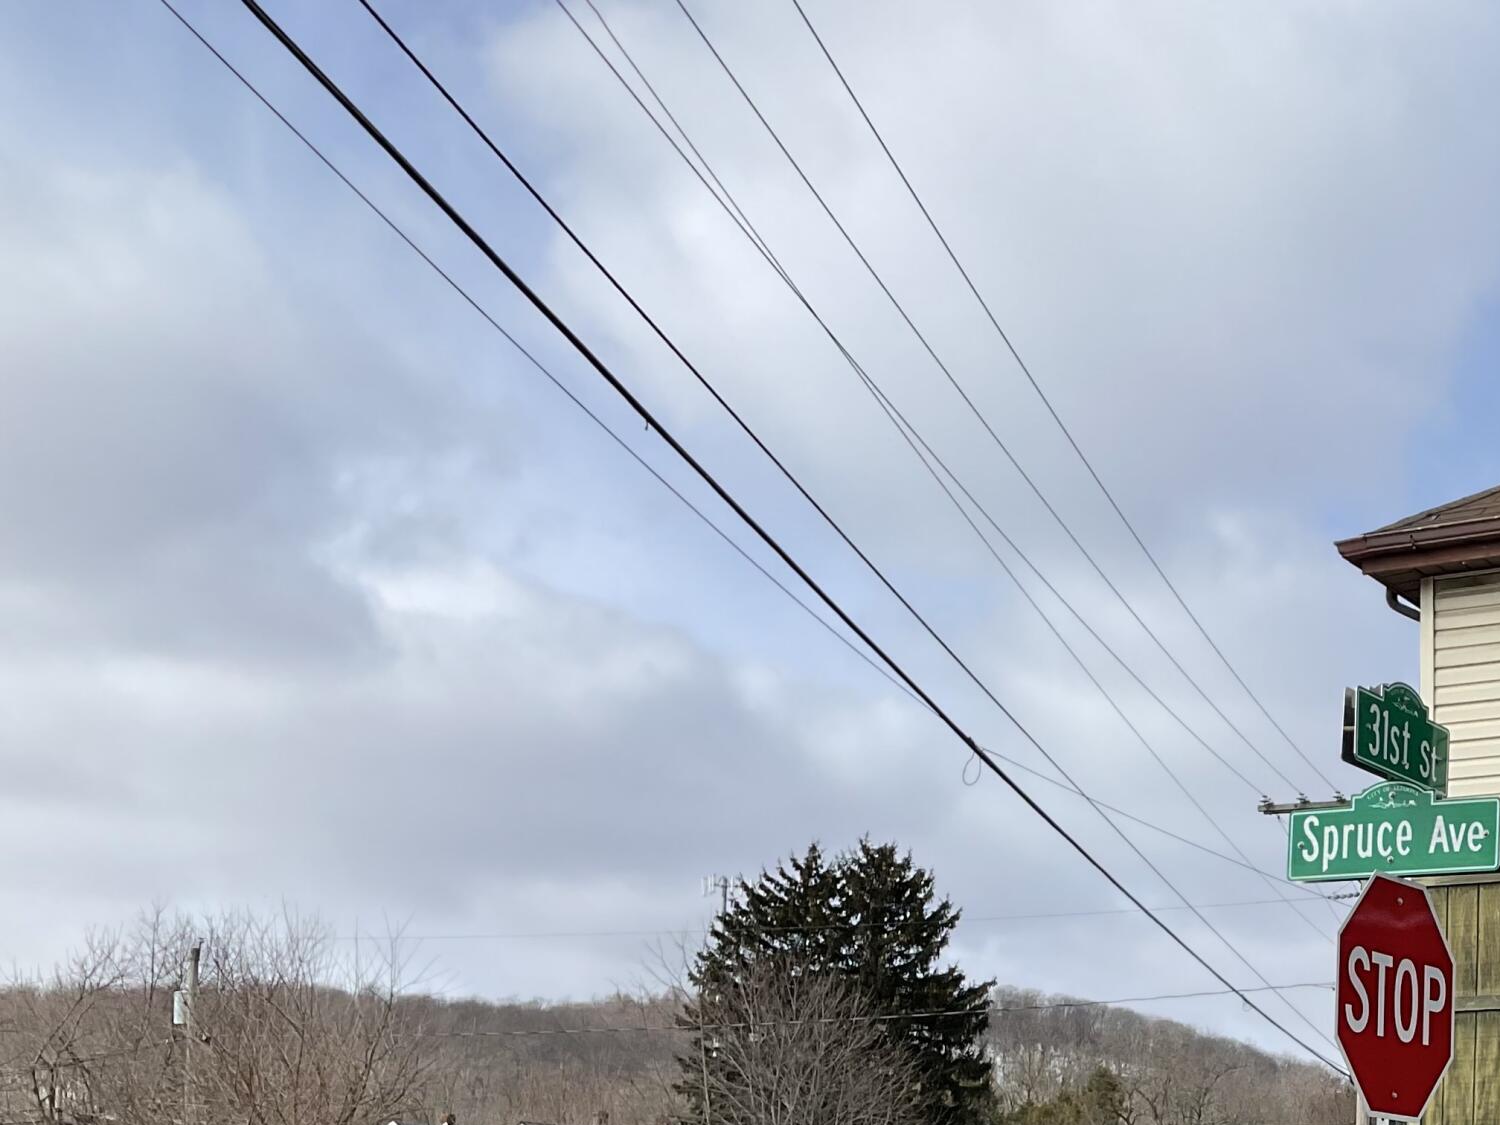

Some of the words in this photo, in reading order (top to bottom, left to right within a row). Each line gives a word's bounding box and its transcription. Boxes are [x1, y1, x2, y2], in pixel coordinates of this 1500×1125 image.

[1368, 704, 1411, 769] 31st
[1419, 740, 1442, 782] St
[1302, 815, 1413, 872] Spruce
[1428, 815, 1483, 854] Ave
[1345, 946, 1446, 1046] STOP
